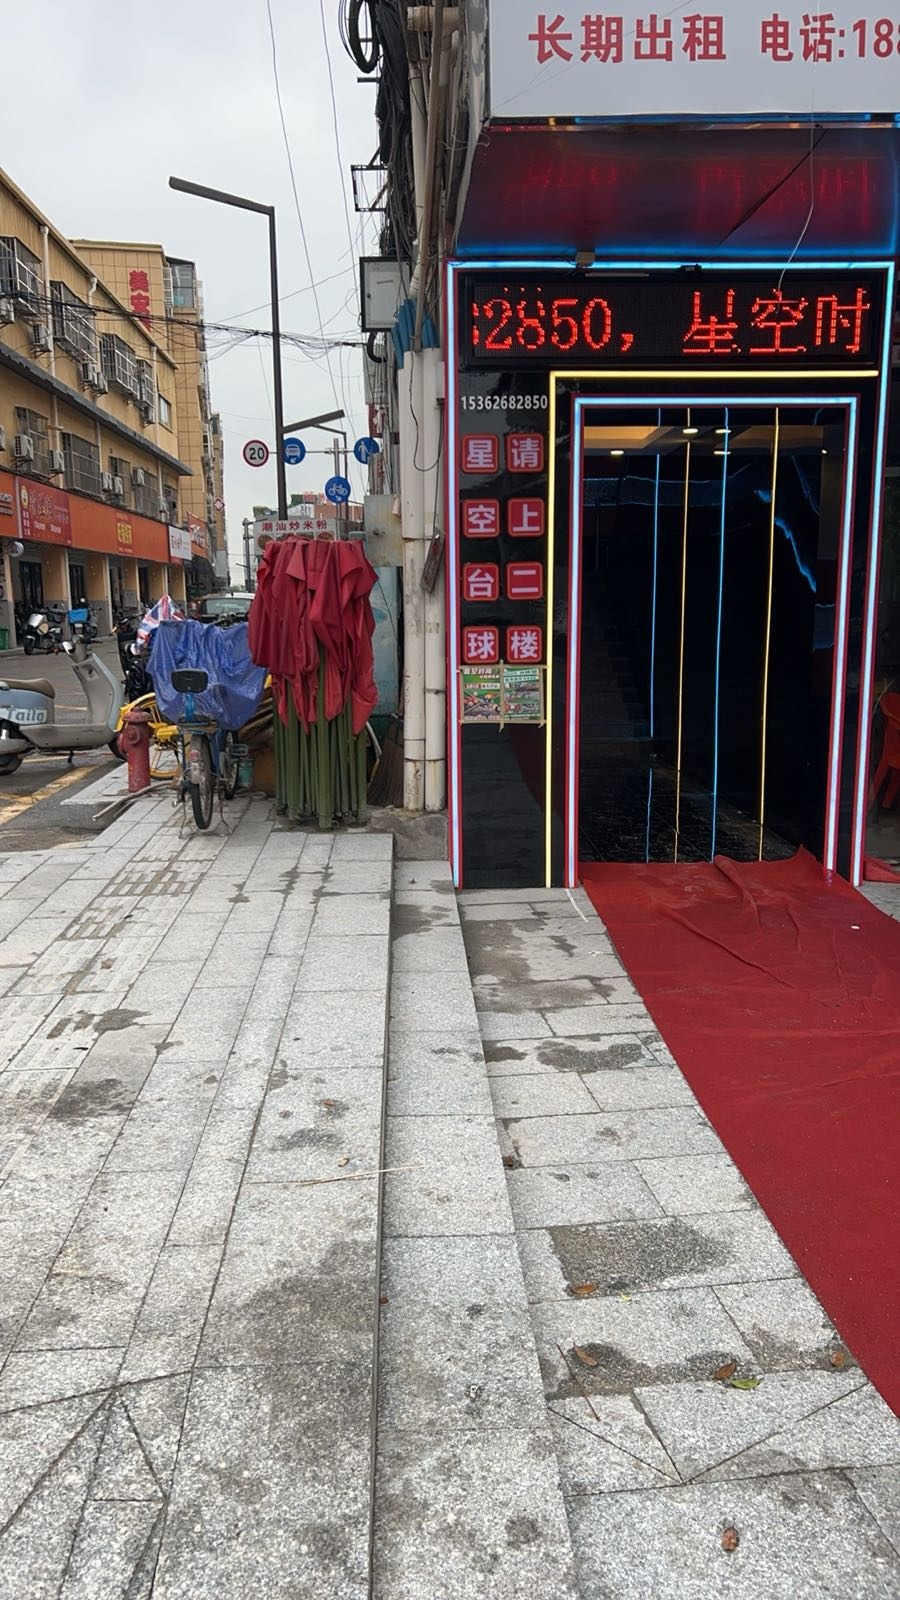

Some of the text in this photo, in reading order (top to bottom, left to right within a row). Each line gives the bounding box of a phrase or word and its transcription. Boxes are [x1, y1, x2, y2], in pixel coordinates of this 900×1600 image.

[528, 13, 900, 64] 长期出租 电话:18
[461, 395, 548, 410] 15362682850
[249, 447, 265, 461] 20
[261, 519, 328, 532] 潮汕炒米粉
